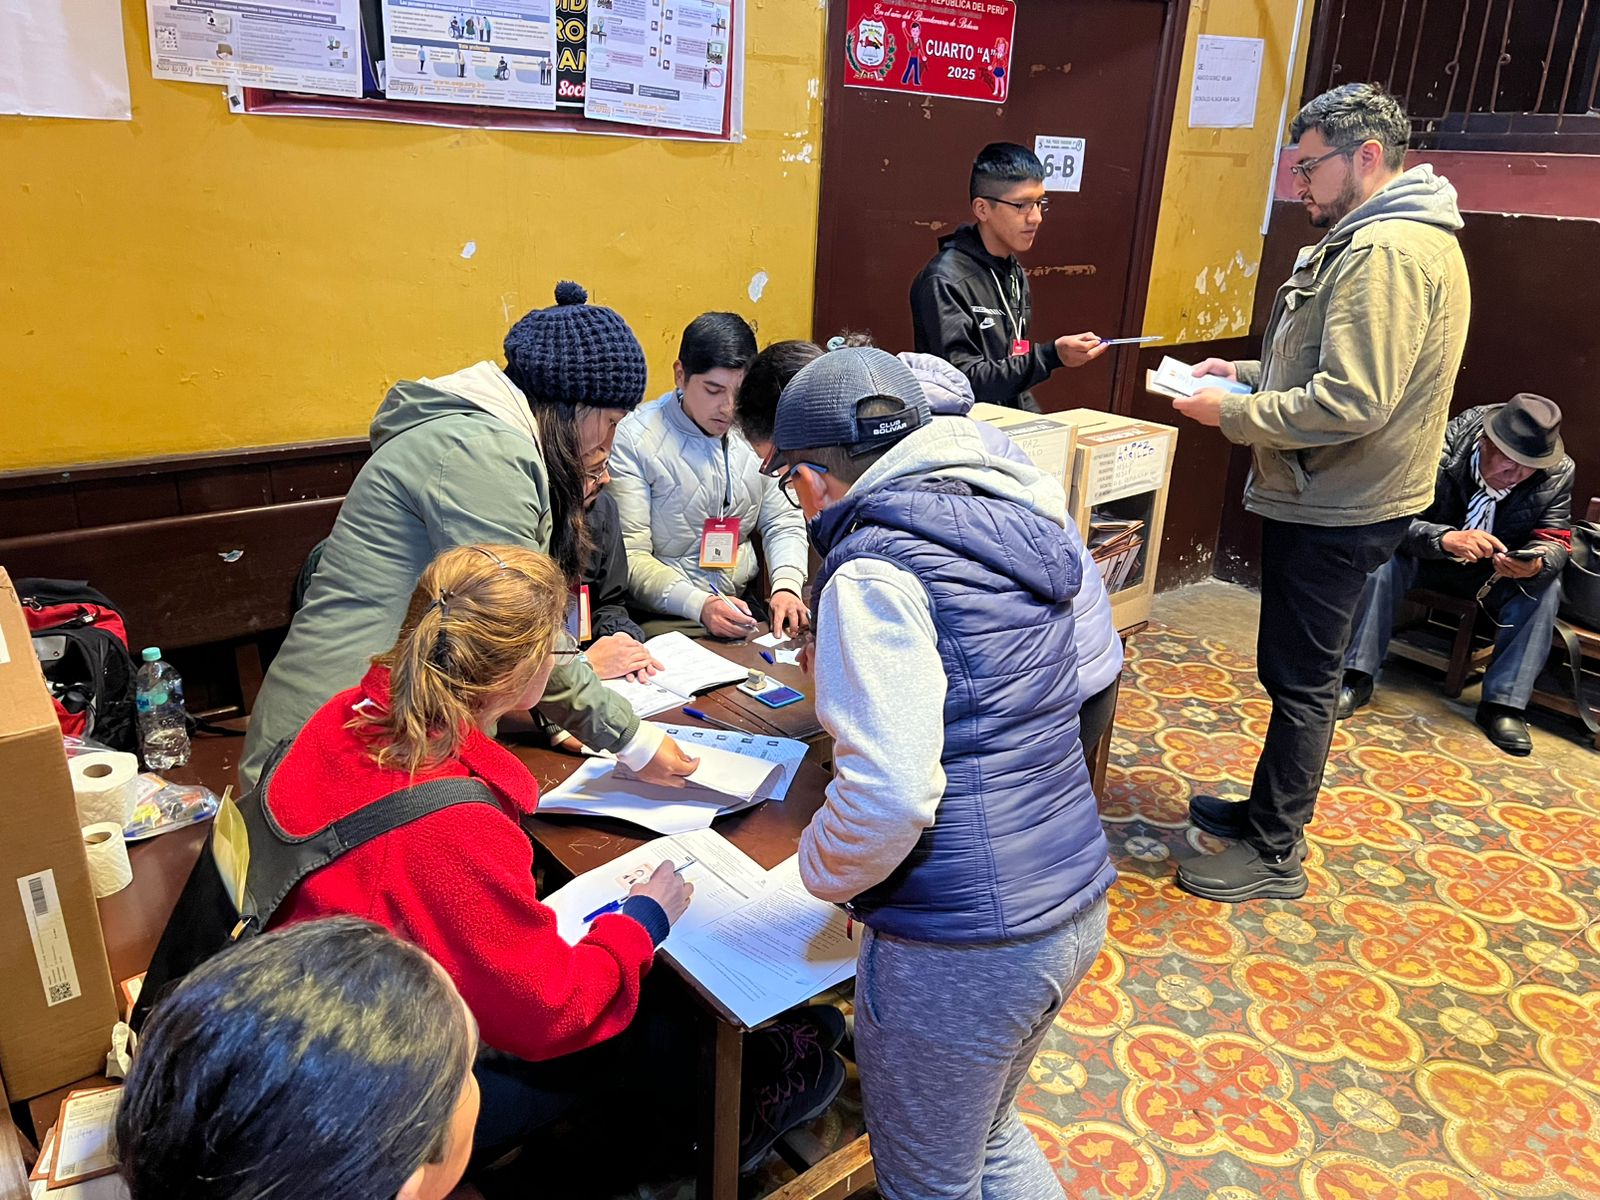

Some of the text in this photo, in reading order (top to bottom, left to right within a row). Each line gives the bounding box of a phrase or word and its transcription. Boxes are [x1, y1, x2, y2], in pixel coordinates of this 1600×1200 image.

[972, 2, 986, 12] DEL
[926, 39, 974, 61] CUARTO
[947, 66, 976, 80] 2025
[1043, 153, 1075, 178] 6-B
[873, 422, 908, 435] BOLIVAR
[879, 419, 901, 429] CLUB
